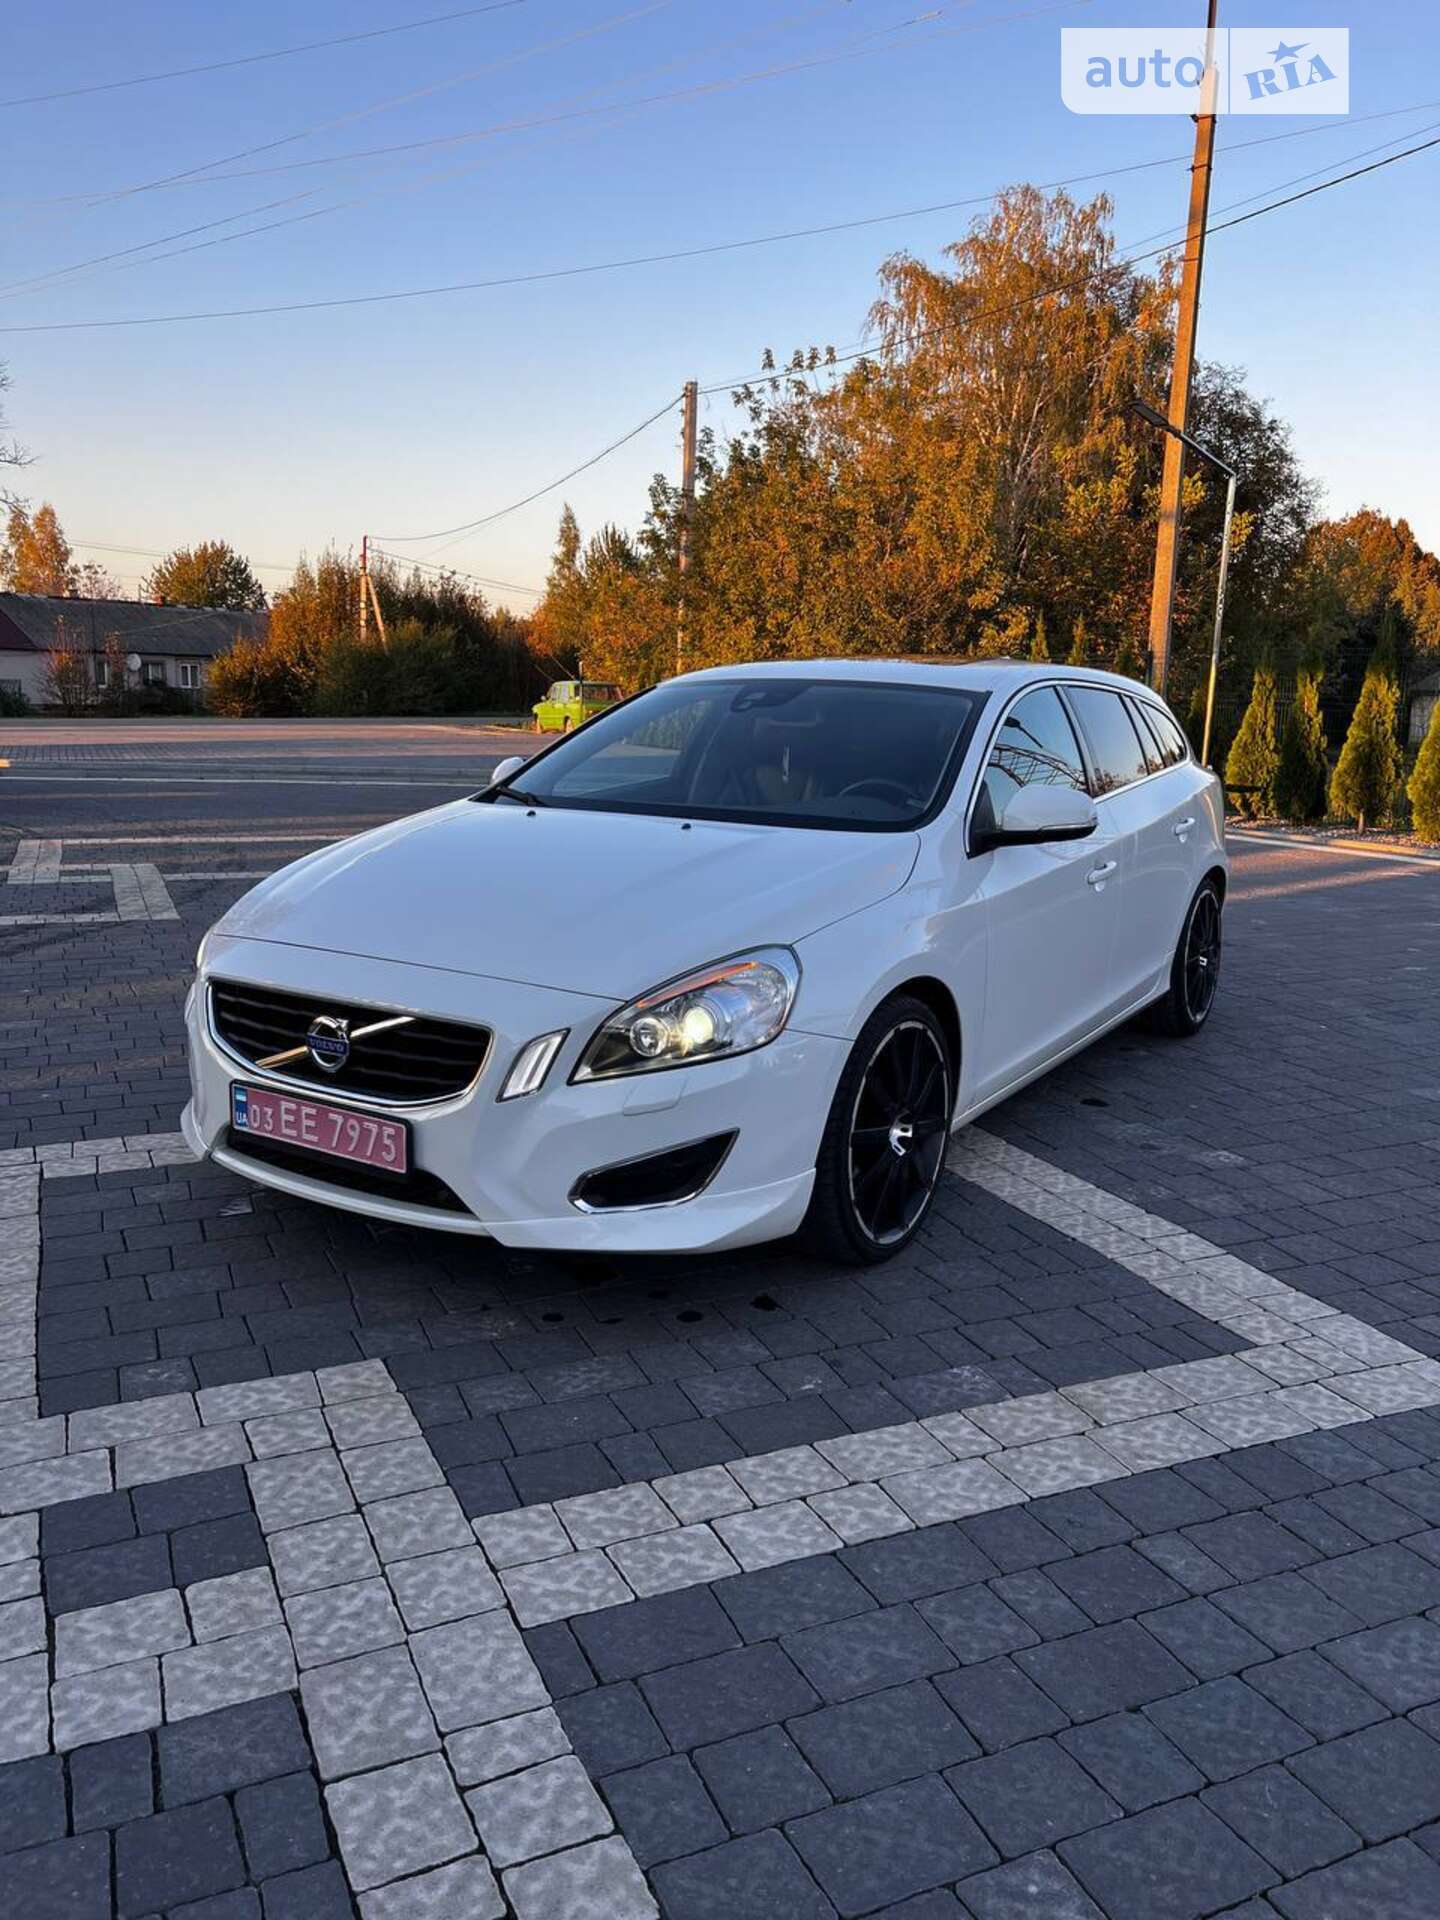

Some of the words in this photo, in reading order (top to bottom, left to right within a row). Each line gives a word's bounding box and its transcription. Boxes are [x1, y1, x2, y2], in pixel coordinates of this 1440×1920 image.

[309, 1037, 345, 1053] VOLVO
[236, 1110, 249, 1126] UA
[328, 1113, 396, 1162] 7975
